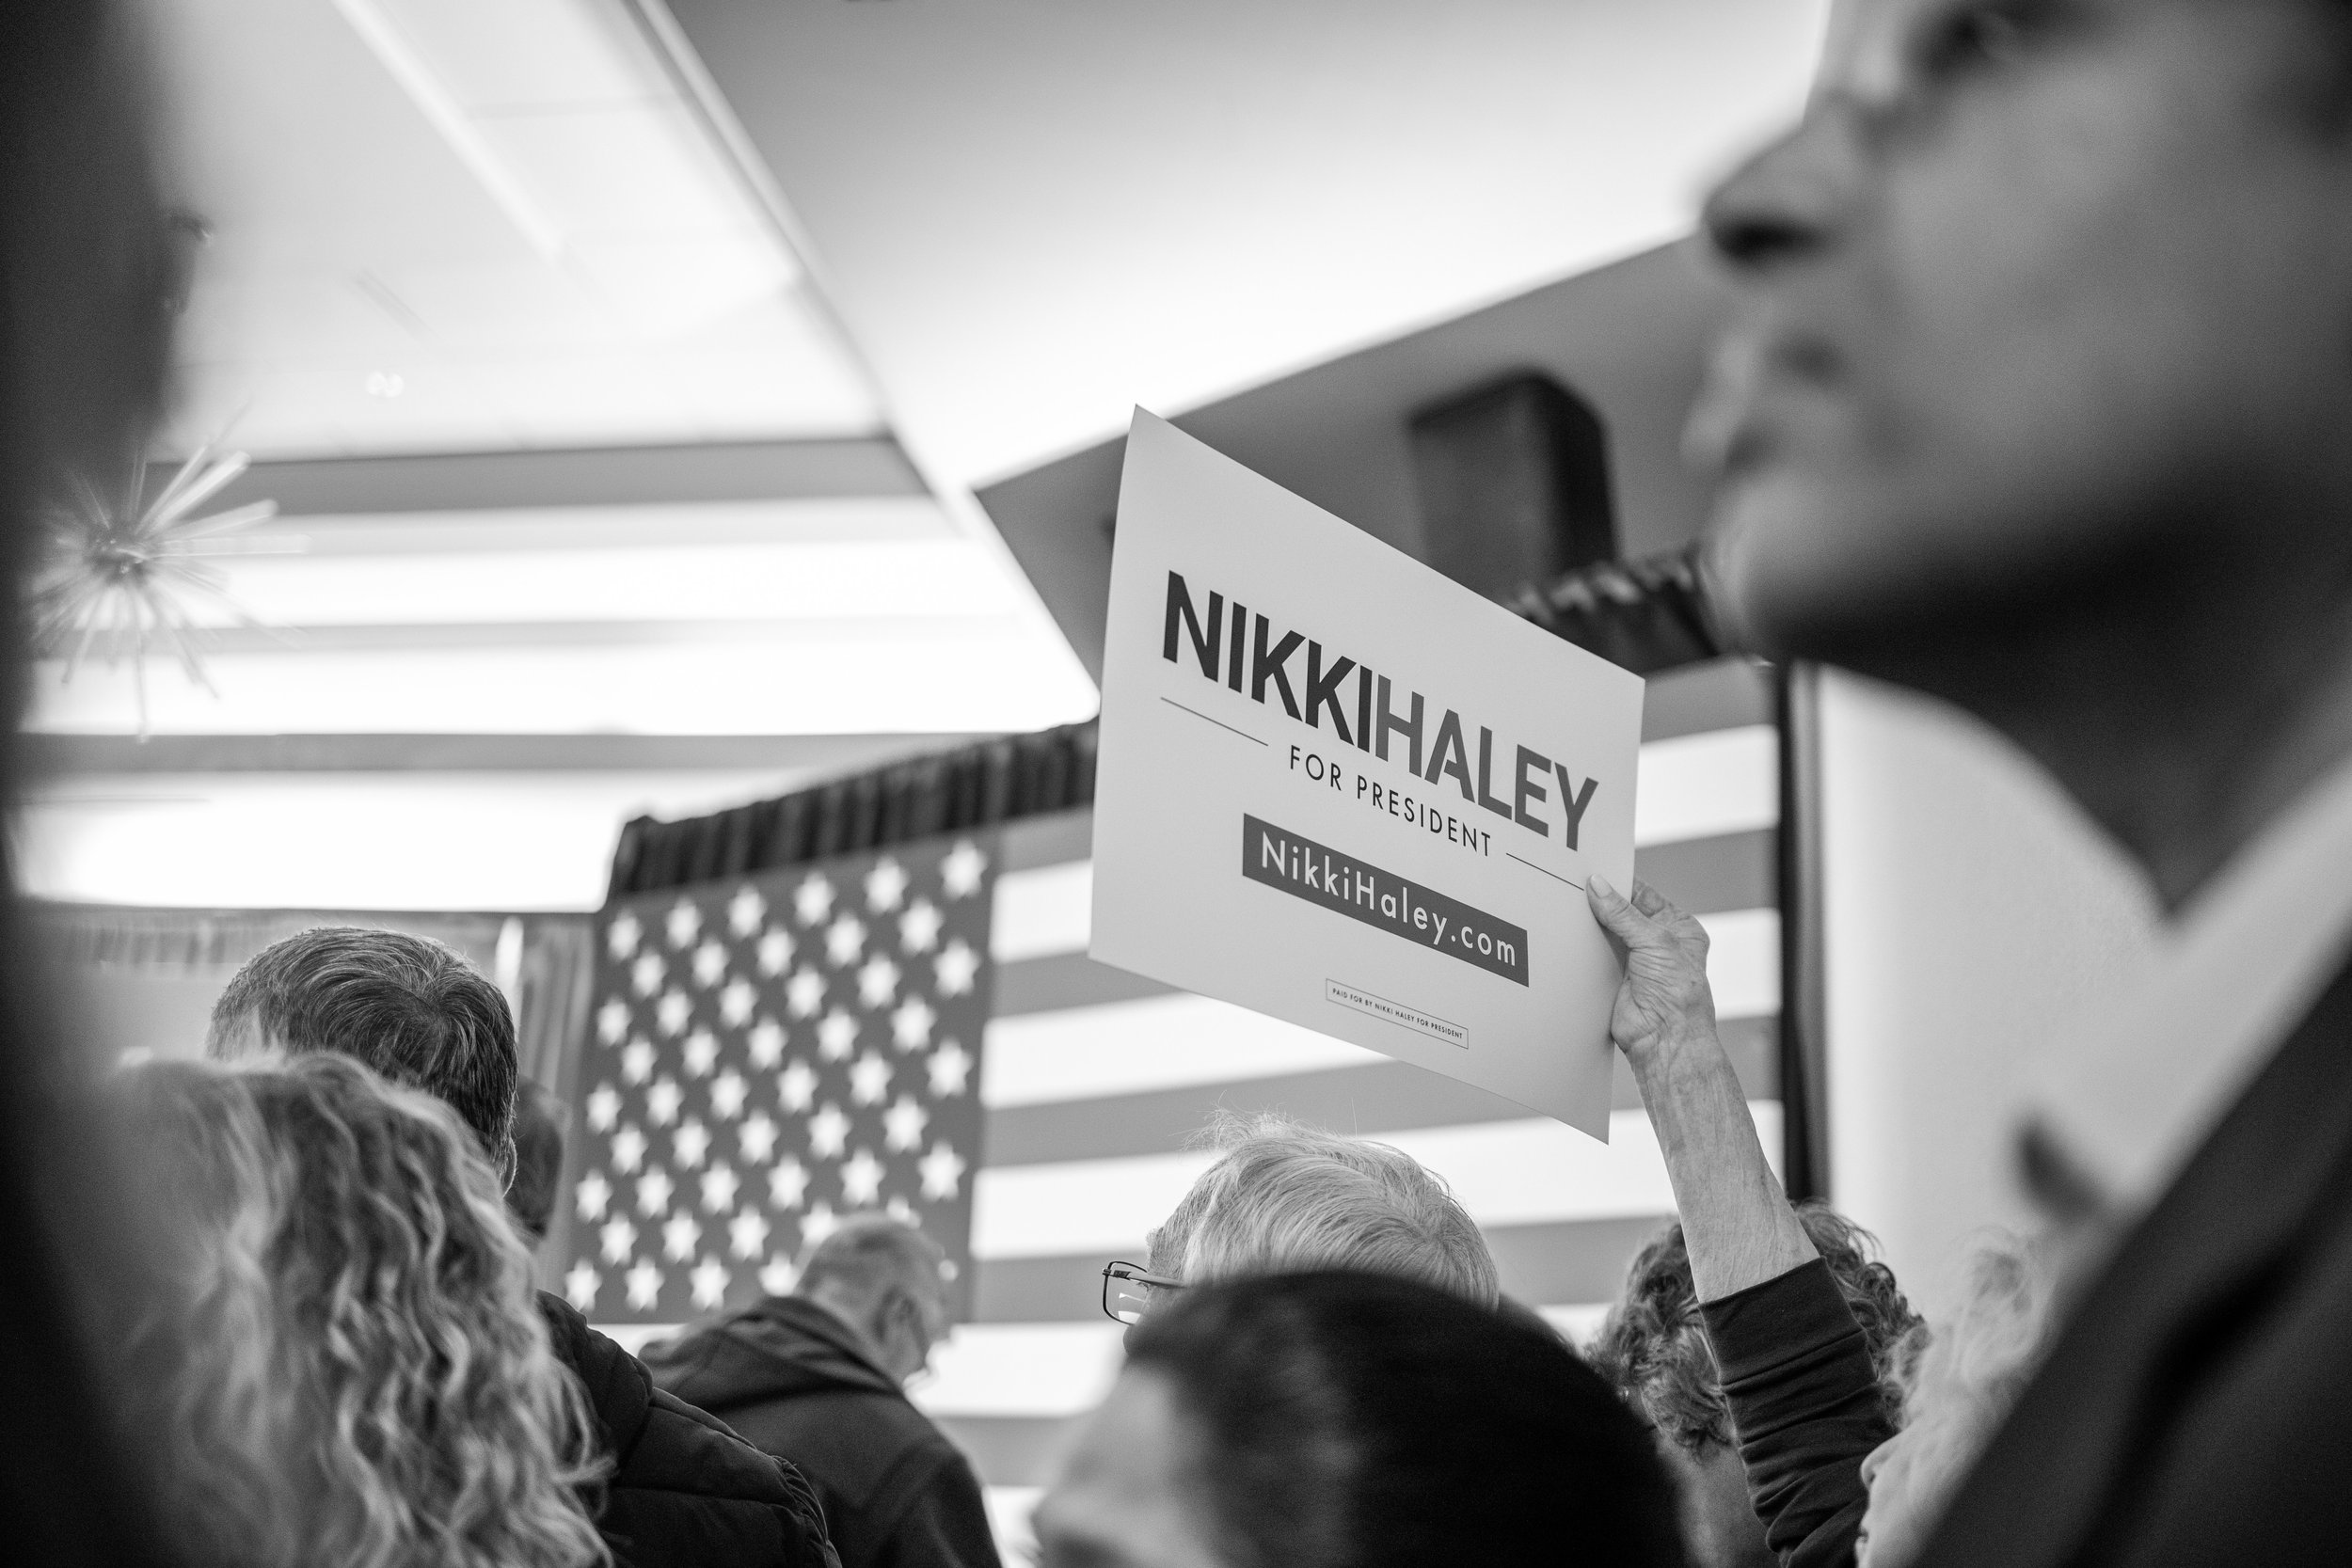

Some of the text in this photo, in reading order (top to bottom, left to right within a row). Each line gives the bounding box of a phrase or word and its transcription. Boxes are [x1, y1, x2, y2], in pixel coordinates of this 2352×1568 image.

[1290, 746, 1490, 856] FOR PRESIDENT
[1262, 832, 1516, 967] NikkiHaley.com
[1332, 988, 1463, 1039] PAID FOR BY NIKKI HALEY FOR PRESIDENT
